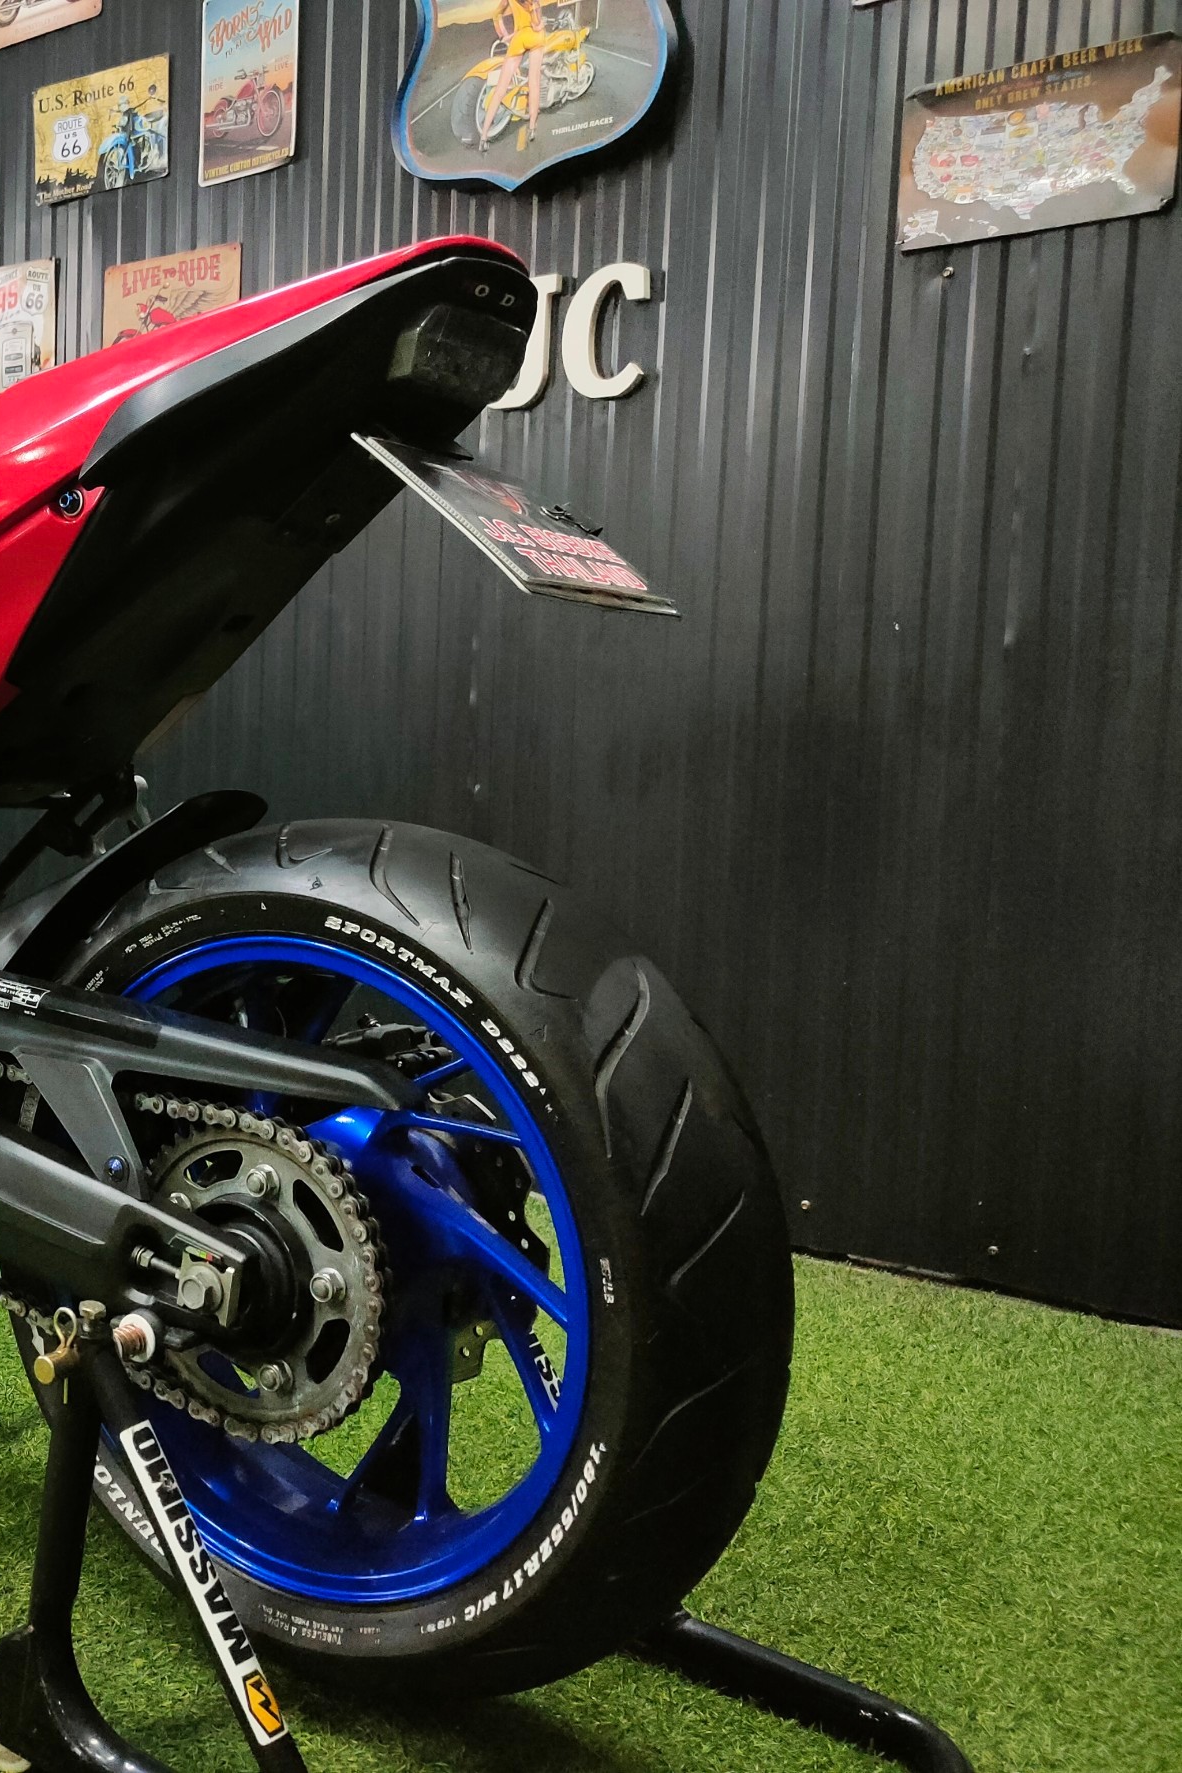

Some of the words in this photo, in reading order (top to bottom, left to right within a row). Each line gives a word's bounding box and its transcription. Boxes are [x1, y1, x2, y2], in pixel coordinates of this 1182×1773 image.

[935, 69, 1005, 96] AMERICAN
[1011, 56, 1057, 80] CRAFT
[1062, 47, 1098, 69] BEER
[1104, 39, 1144, 59] WEEK
[39, 94, 67, 114] U.S.
[73, 83, 114, 107] Route
[118, 75, 135, 93] 66
[975, 94, 1003, 110] ONLY
[57, 118, 83, 131] ROUTE
[552, 122, 588, 135] THRILLING
[589, 116, 613, 127] RACES
[61, 139, 82, 158] 66
[27, 270, 49, 280] ROUTE
[122, 265, 161, 298] LIVE
[178, 254, 221, 288] RIDE
[25, 292, 43, 310] 66
[514, 546, 648, 591] THAILAND
[324, 915, 473, 1008] SPORTMAX
[93, 1454, 166, 1557] UNLO
[131, 1426, 255, 1666] MASSIMO
